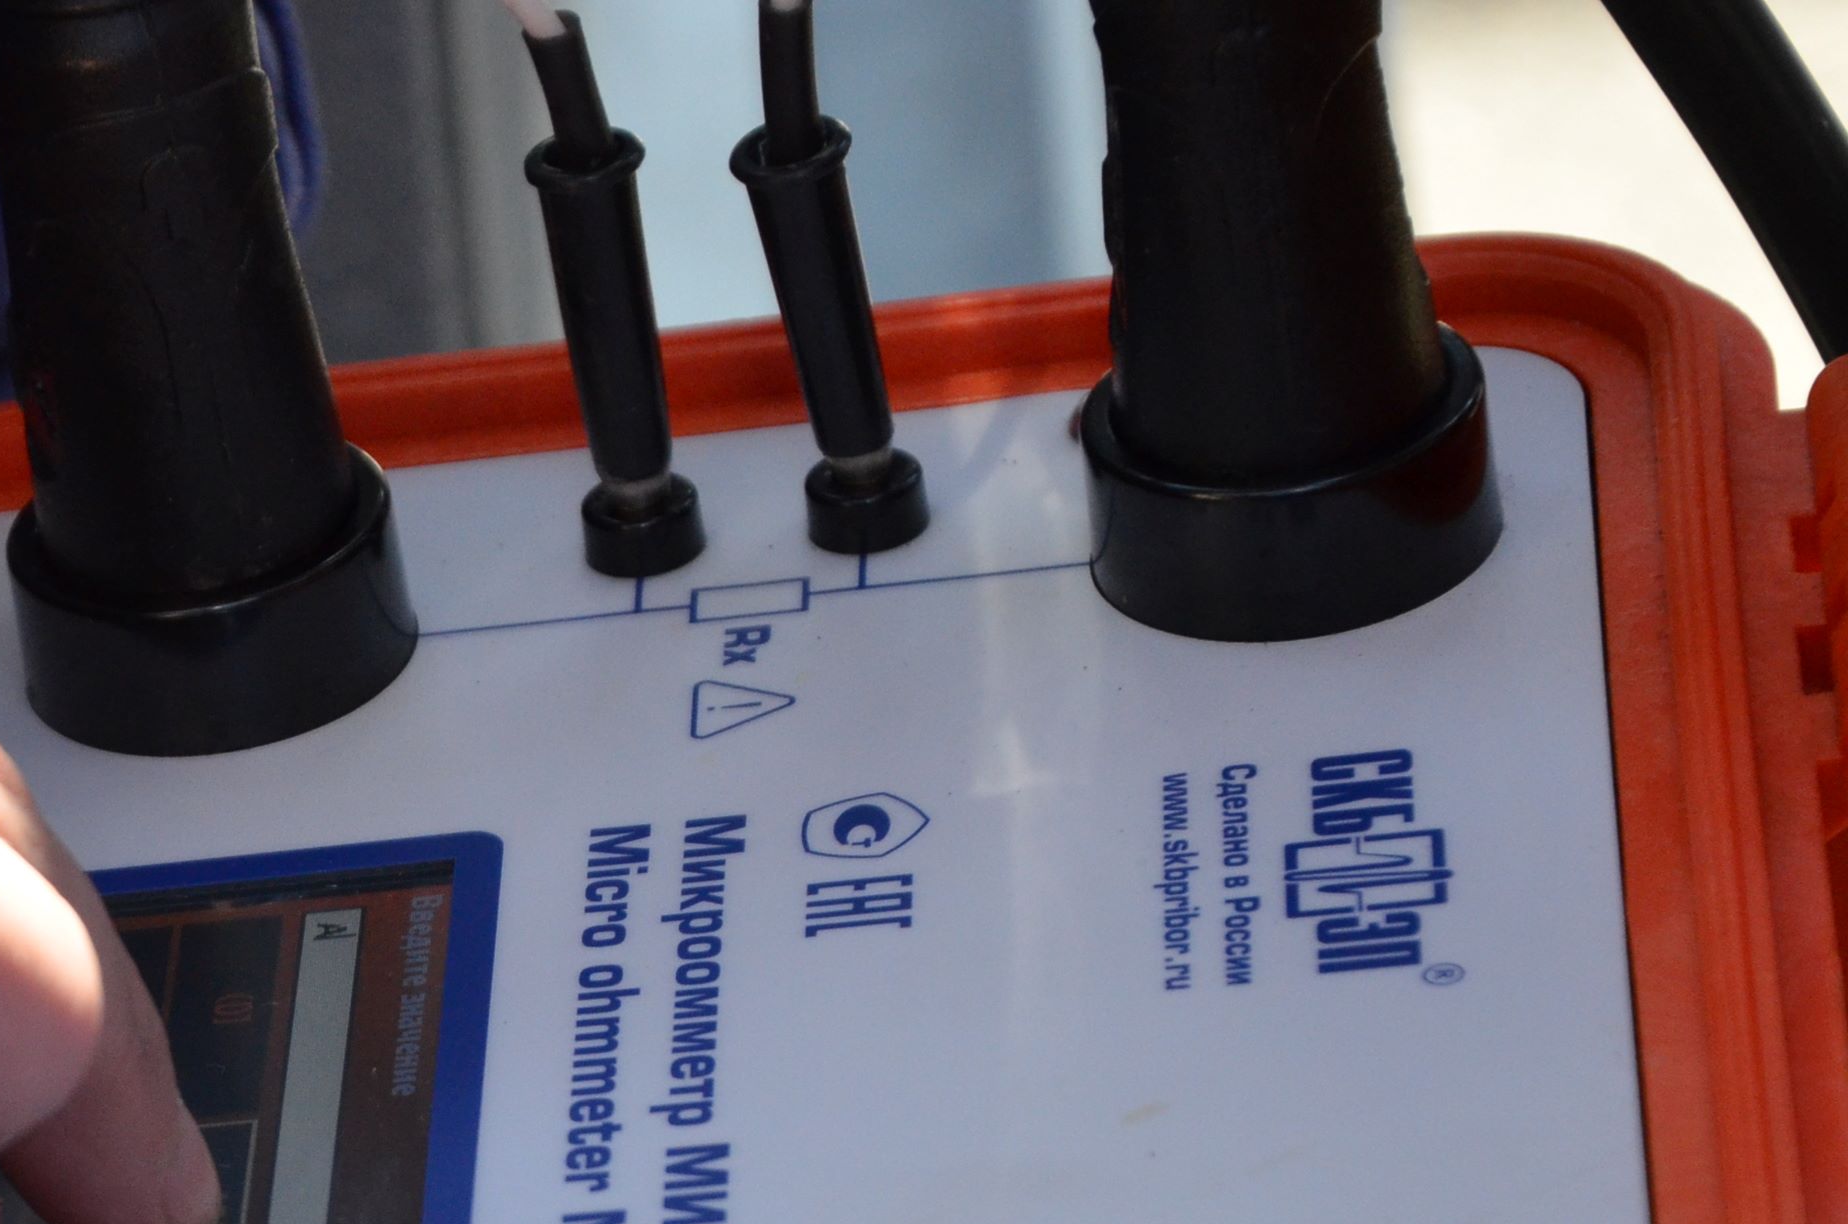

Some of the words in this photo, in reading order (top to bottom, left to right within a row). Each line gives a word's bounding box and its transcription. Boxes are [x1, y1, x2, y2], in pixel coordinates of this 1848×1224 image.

[723, 624, 772, 667] Rx
[1216, 763, 1258, 868] Сделано
[1310, 748, 1415, 837] СКБ
[580, 823, 652, 948] Micro
[1152, 772, 1200, 992] www.skbpribor.ru
[1224, 874, 1250, 890] в
[400, 894, 445, 987] Введите
[649, 814, 747, 1127] Микроомметр
[1224, 895, 1262, 988] России
[390, 991, 426, 1097] значение
[564, 963, 641, 1193] ohmmeter
